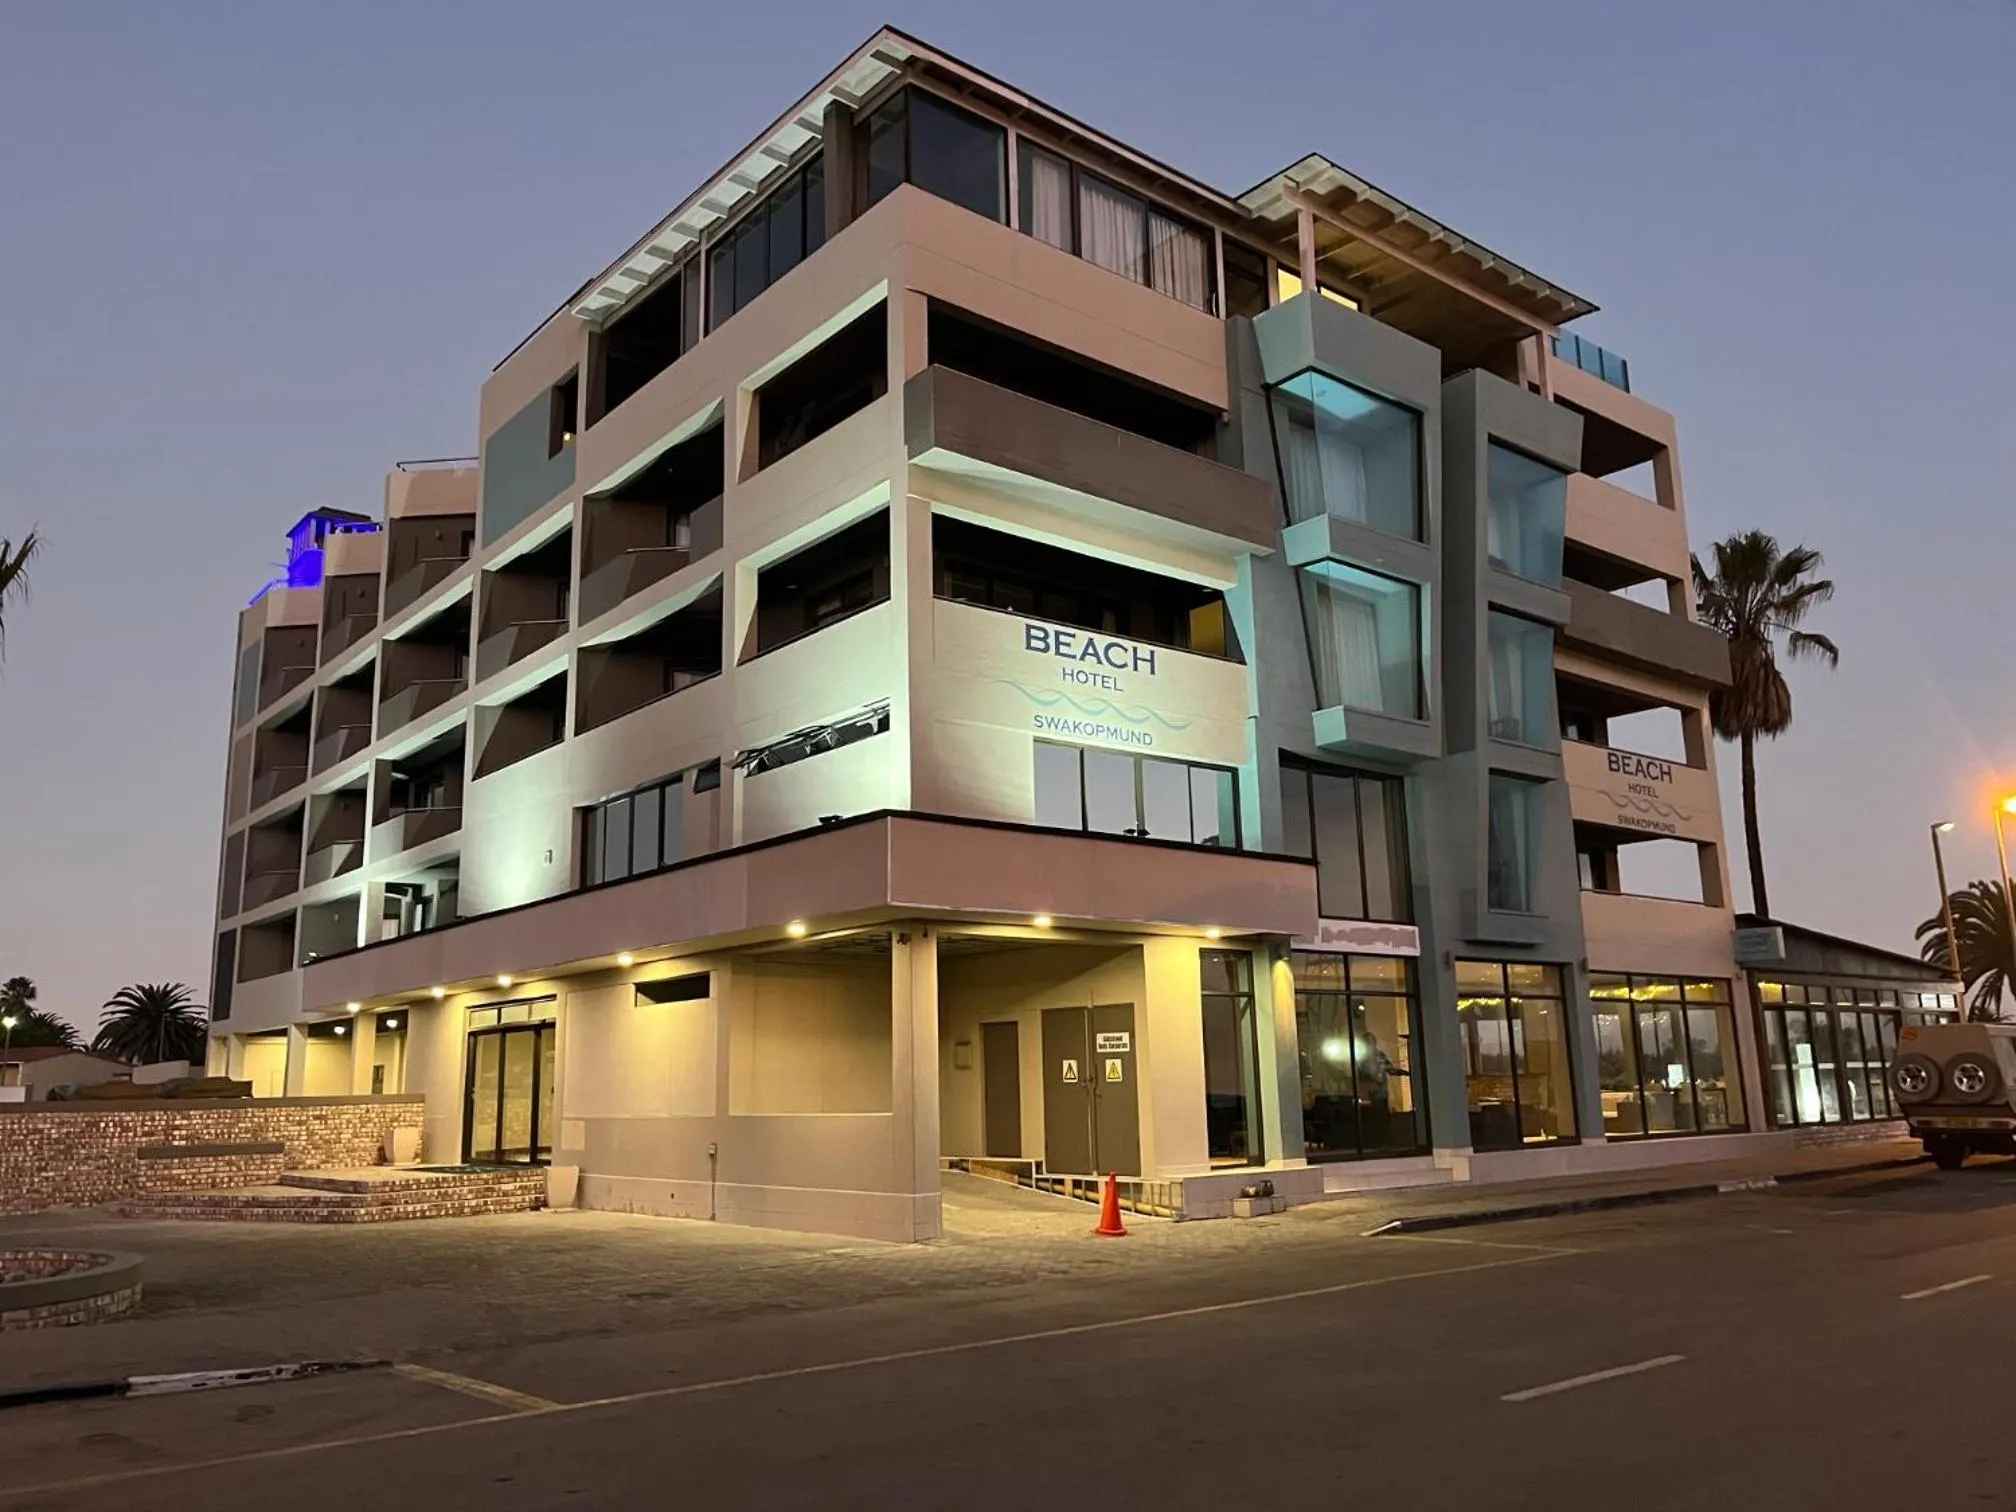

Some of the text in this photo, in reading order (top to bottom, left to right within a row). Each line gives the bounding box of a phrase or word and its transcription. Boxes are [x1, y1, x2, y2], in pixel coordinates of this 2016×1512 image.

[1025, 623, 1156, 675] BEACH
[1062, 667, 1124, 692] HOTEL
[1034, 715, 1153, 745] SWAKOPMUND
[1607, 752, 1673, 784] BEACH
[1628, 783, 1659, 798] HOTEL
